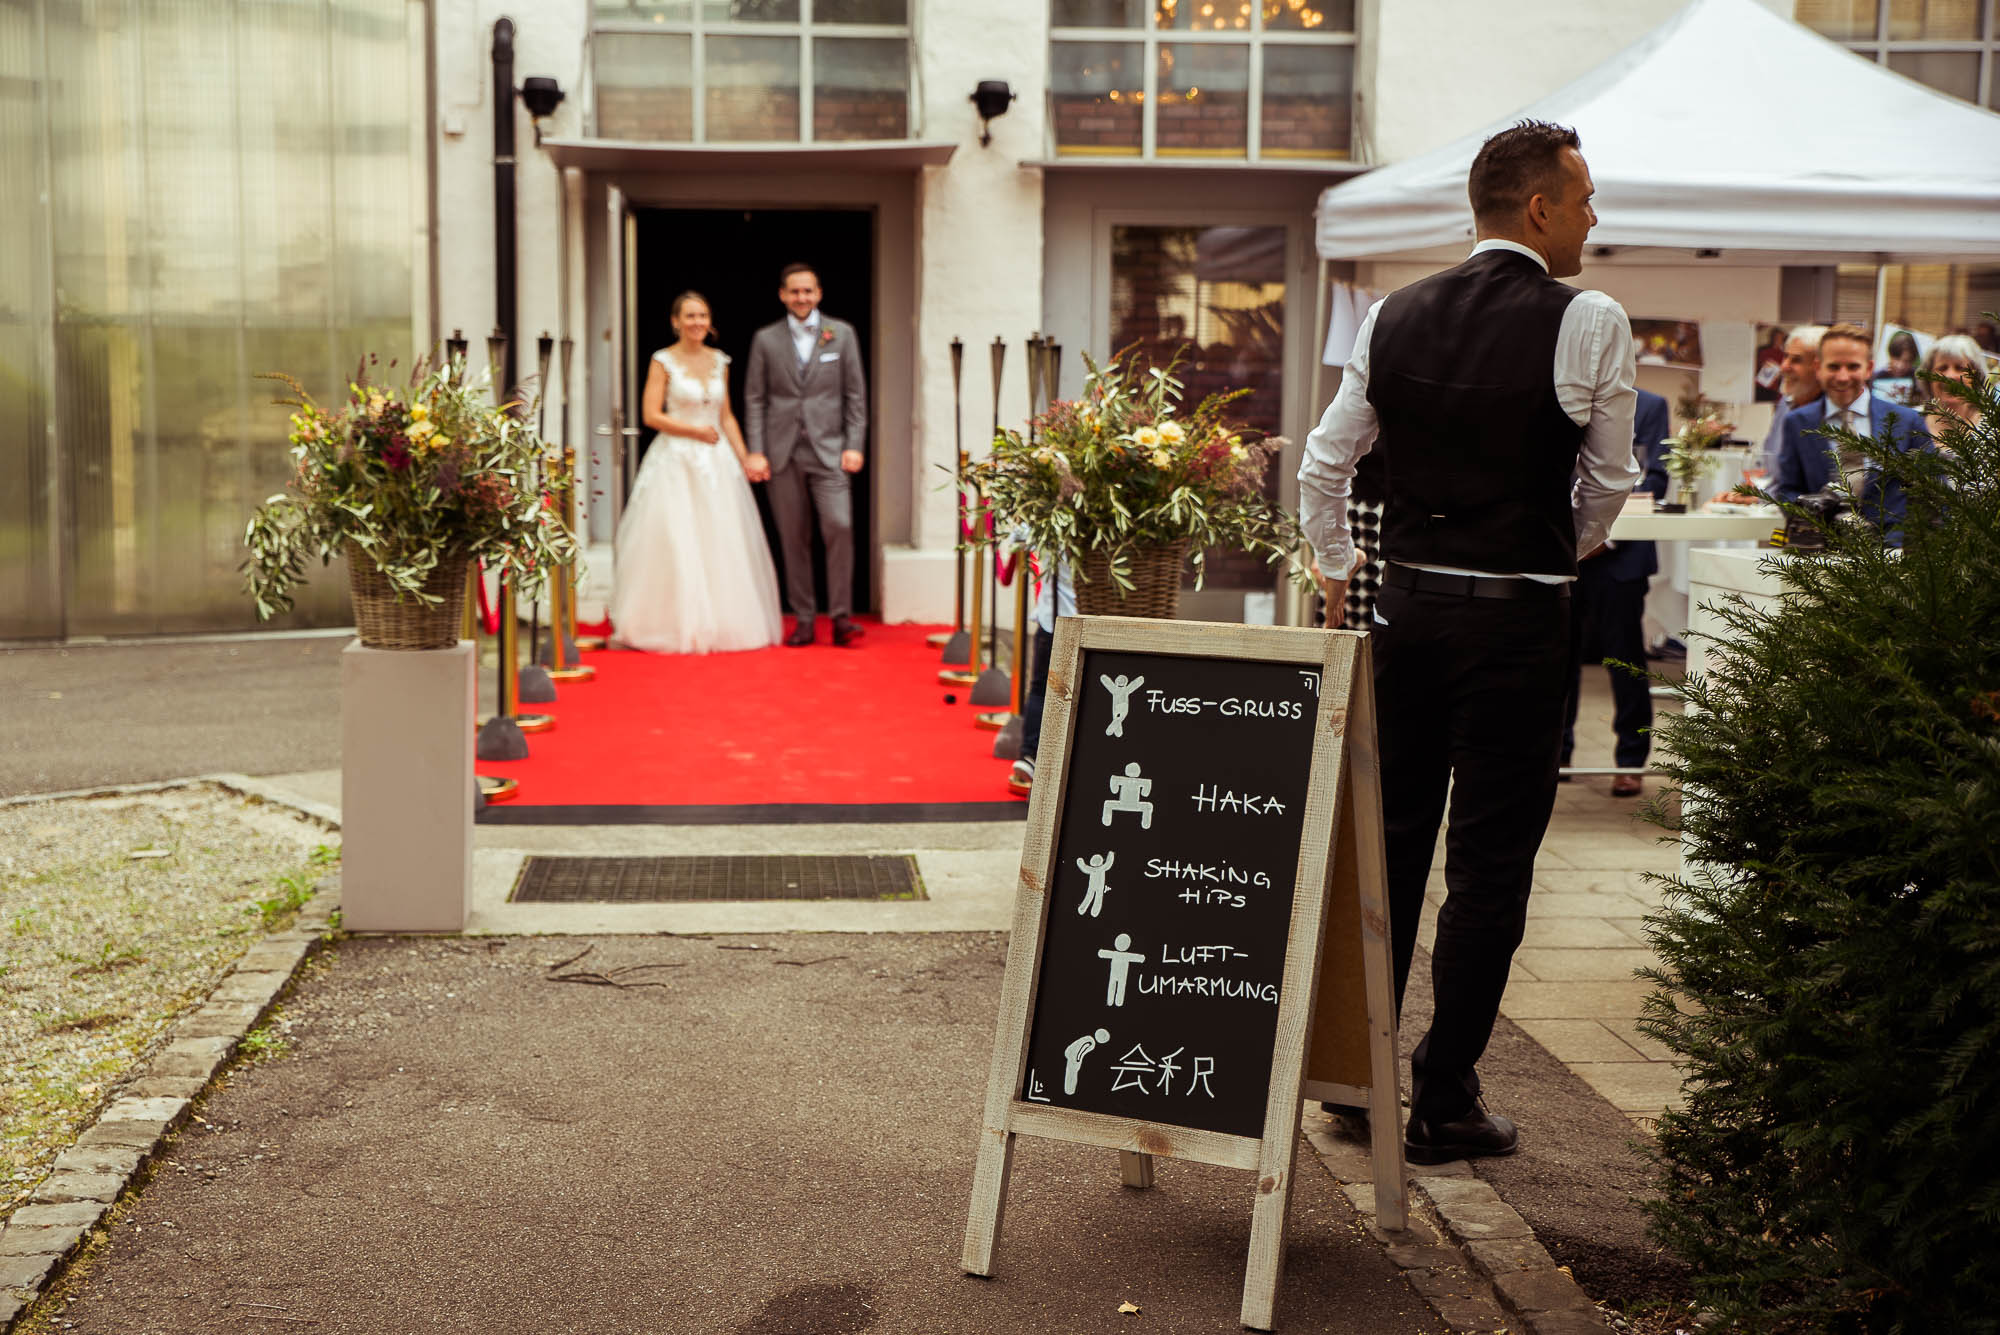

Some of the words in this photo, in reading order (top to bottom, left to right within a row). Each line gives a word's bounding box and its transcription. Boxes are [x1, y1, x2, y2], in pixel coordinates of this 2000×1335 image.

[1146, 689, 1303, 720] FUSS-GRUSS
[1191, 783, 1286, 816] HAKA
[1161, 943, 1249, 966] LUFT-
[1138, 973, 1278, 1005] UMARMUNG
